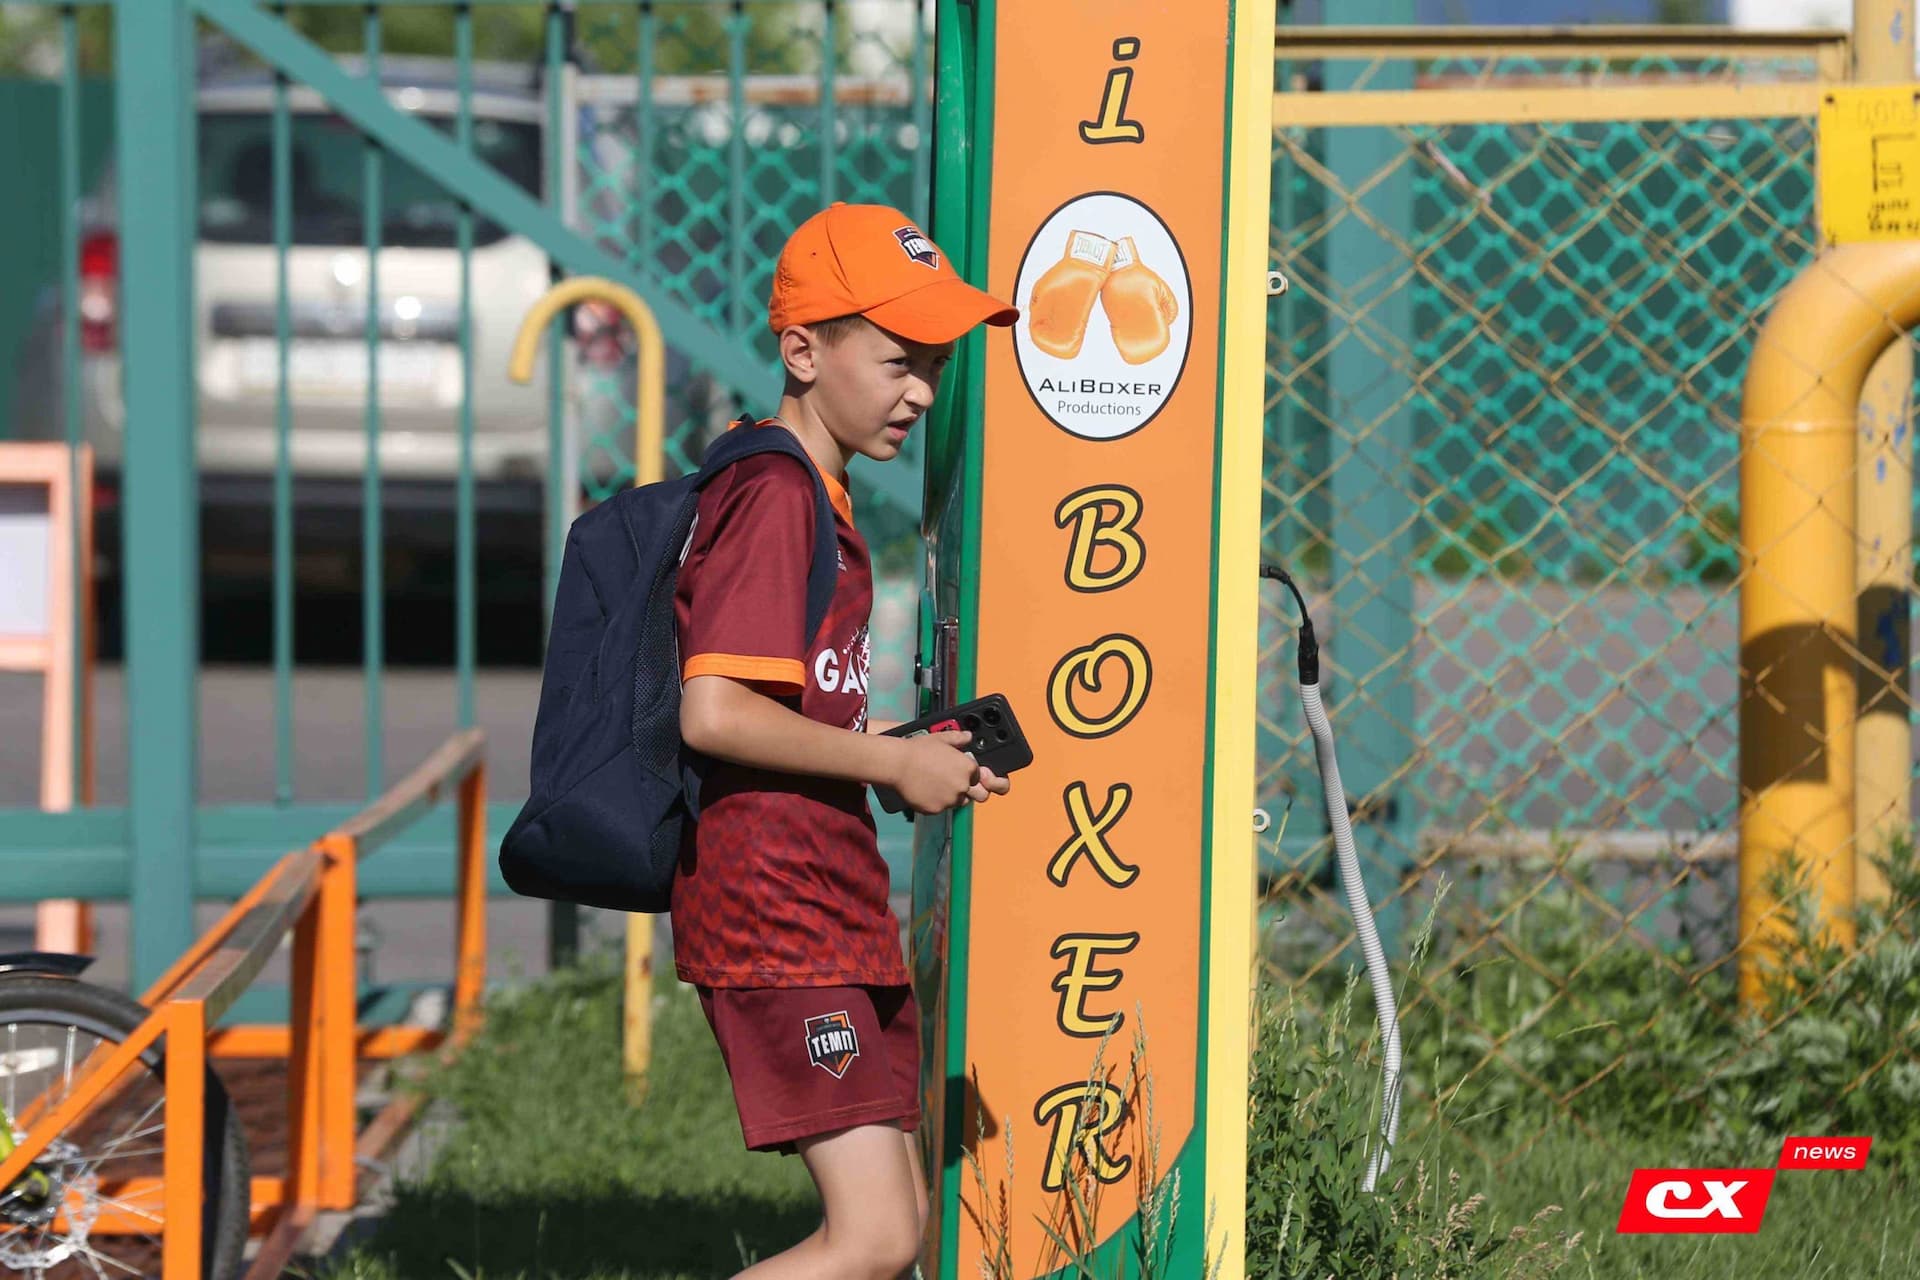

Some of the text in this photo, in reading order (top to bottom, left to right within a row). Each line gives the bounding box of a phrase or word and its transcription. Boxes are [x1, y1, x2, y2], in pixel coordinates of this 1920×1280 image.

[1057, 400, 1142, 416] Productions
[1033, 484, 1153, 1193] BOXER
[811, 1031, 853, 1058] ТЕМП
